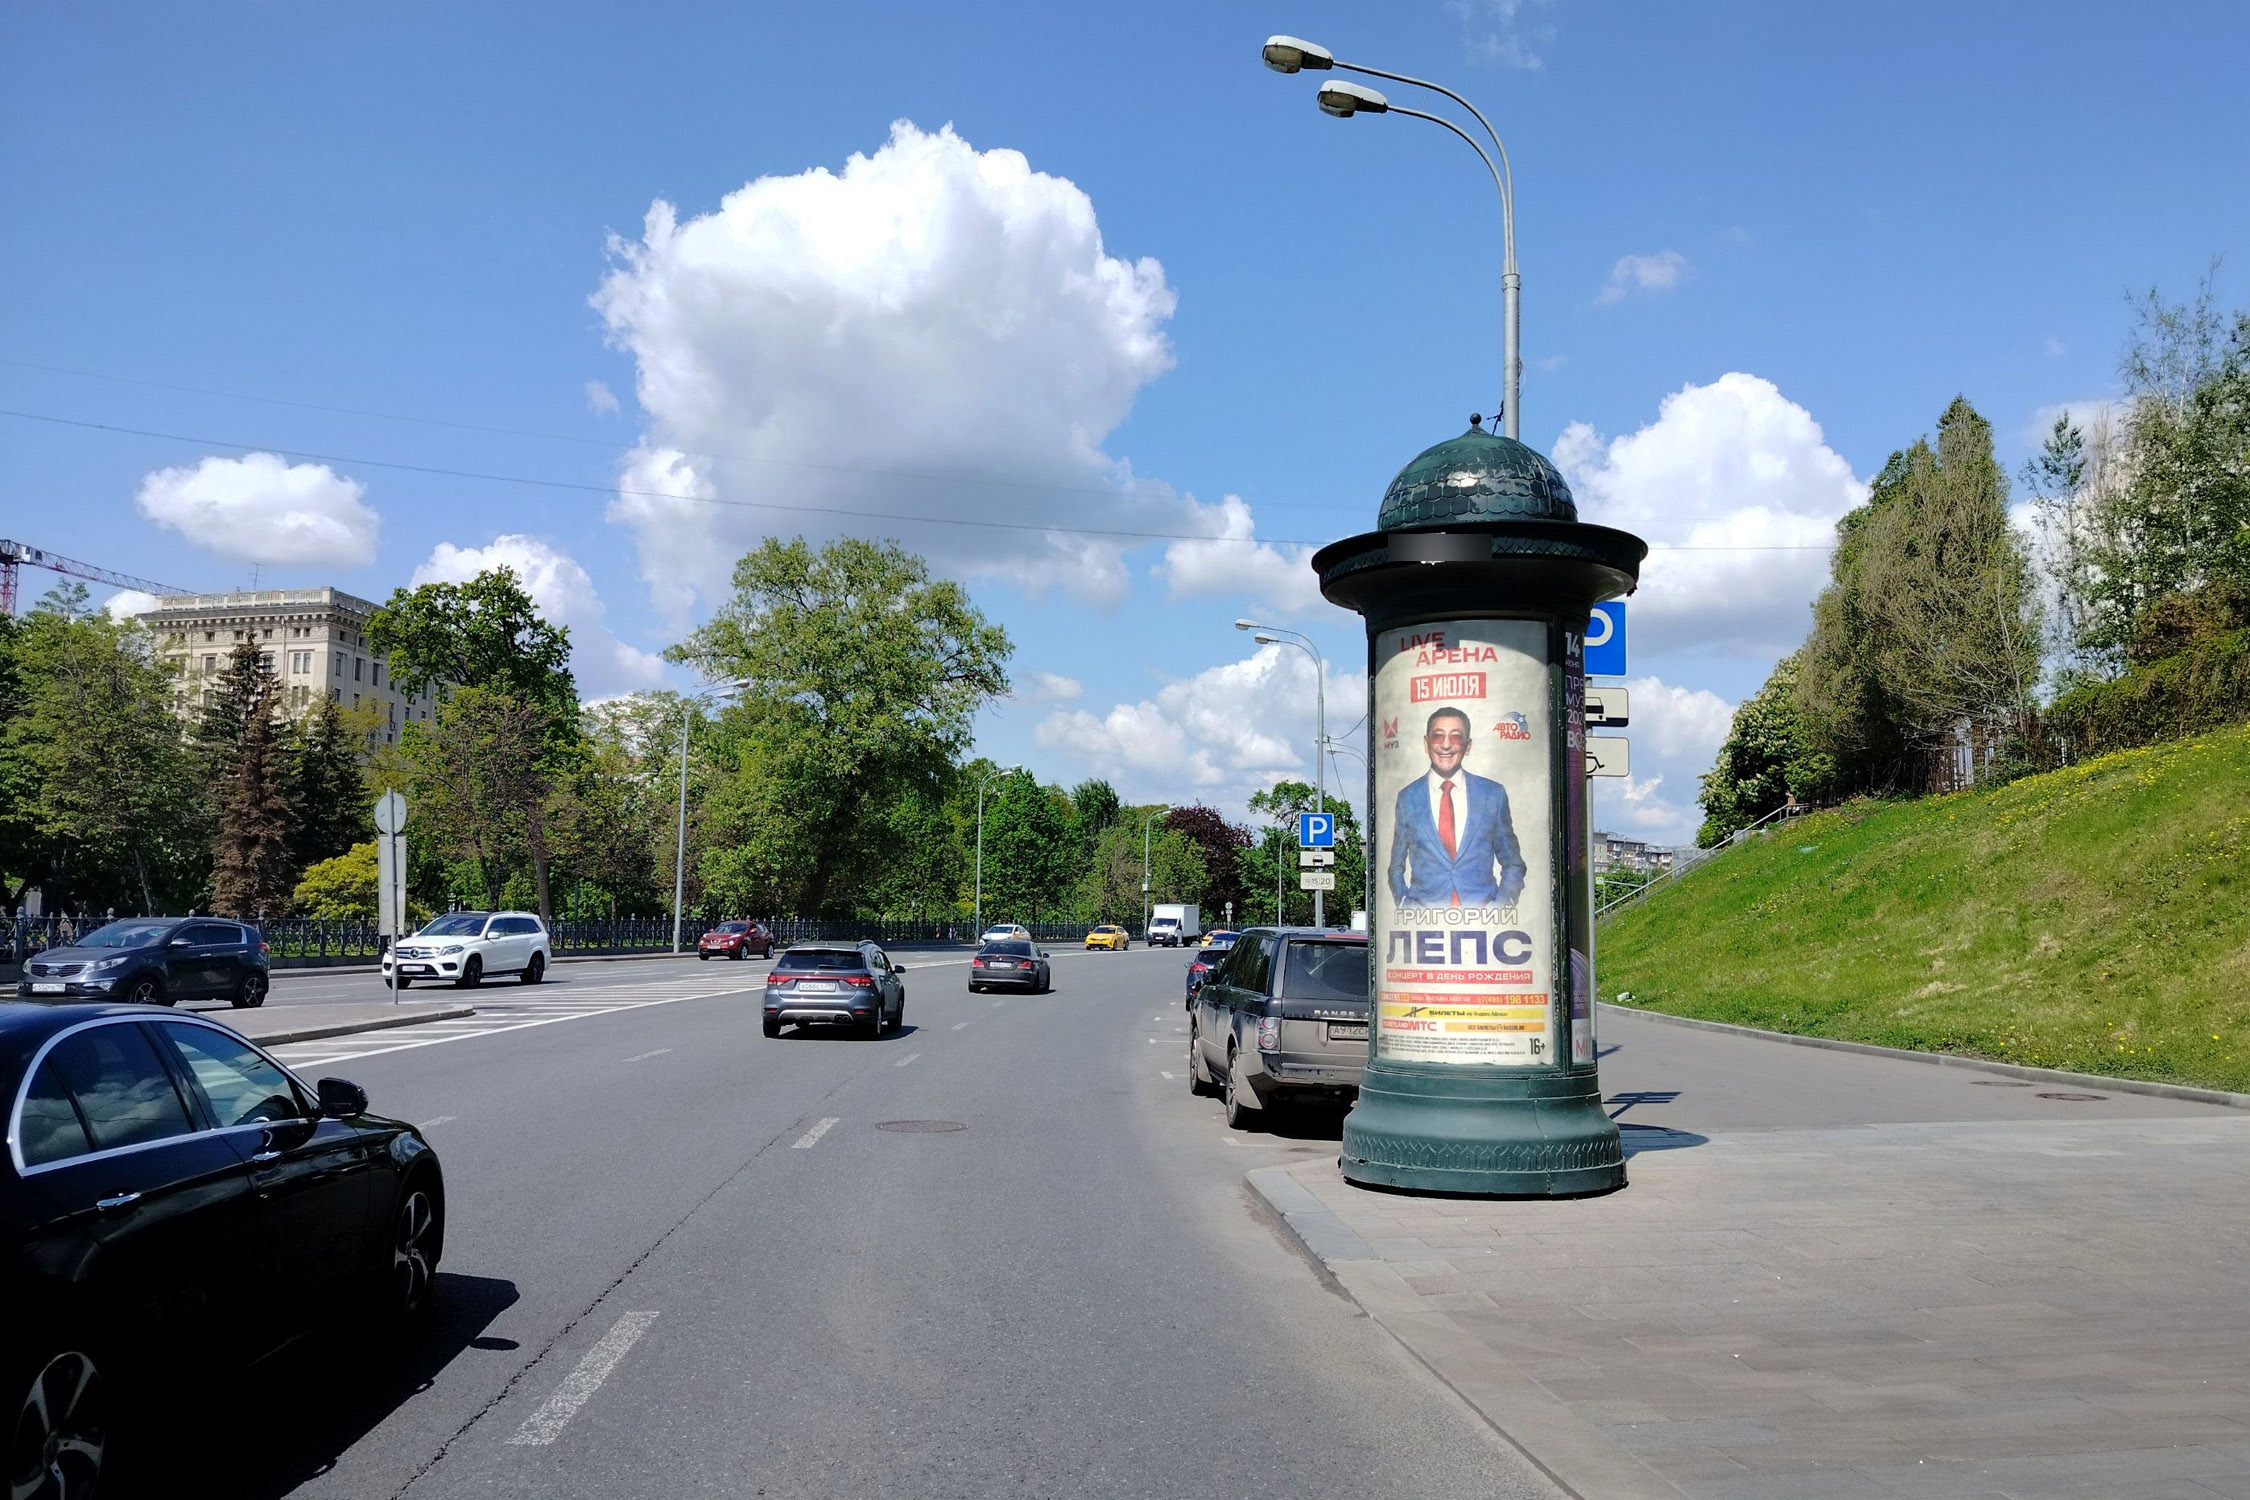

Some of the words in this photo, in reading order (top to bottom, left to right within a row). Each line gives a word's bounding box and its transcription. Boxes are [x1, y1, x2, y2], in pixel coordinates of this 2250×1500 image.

[1401, 632, 1445, 651] LIVE
[1565, 632, 1580, 657] 14
[1416, 647, 1498, 666] АРЕНА
[1416, 679, 1429, 699] 15
[1433, 676, 1479, 697] ИЮЛЯ
[1492, 722, 1518, 732] АВТО
[1500, 731, 1531, 740] РАДИО
[1384, 741, 1399, 750] МУЗ
[1309, 817, 1328, 843] P
[1394, 905, 1518, 925] ГРИГОРИЙ
[1386, 930, 1532, 965] ЛЕПС
[1387, 971, 1424, 979] КОНЦЕРТ
[1426, 972, 1434, 980] В
[1436, 972, 1465, 981] ДЕНЬ
[1468, 973, 1531, 981] РОЖДЕНИЯ
[1504, 995, 1521, 1004] 198
[1523, 995, 1545, 1004] 1133
[1409, 1020, 1437, 1032] МТС
[1530, 1038, 1546, 1056] 16+
